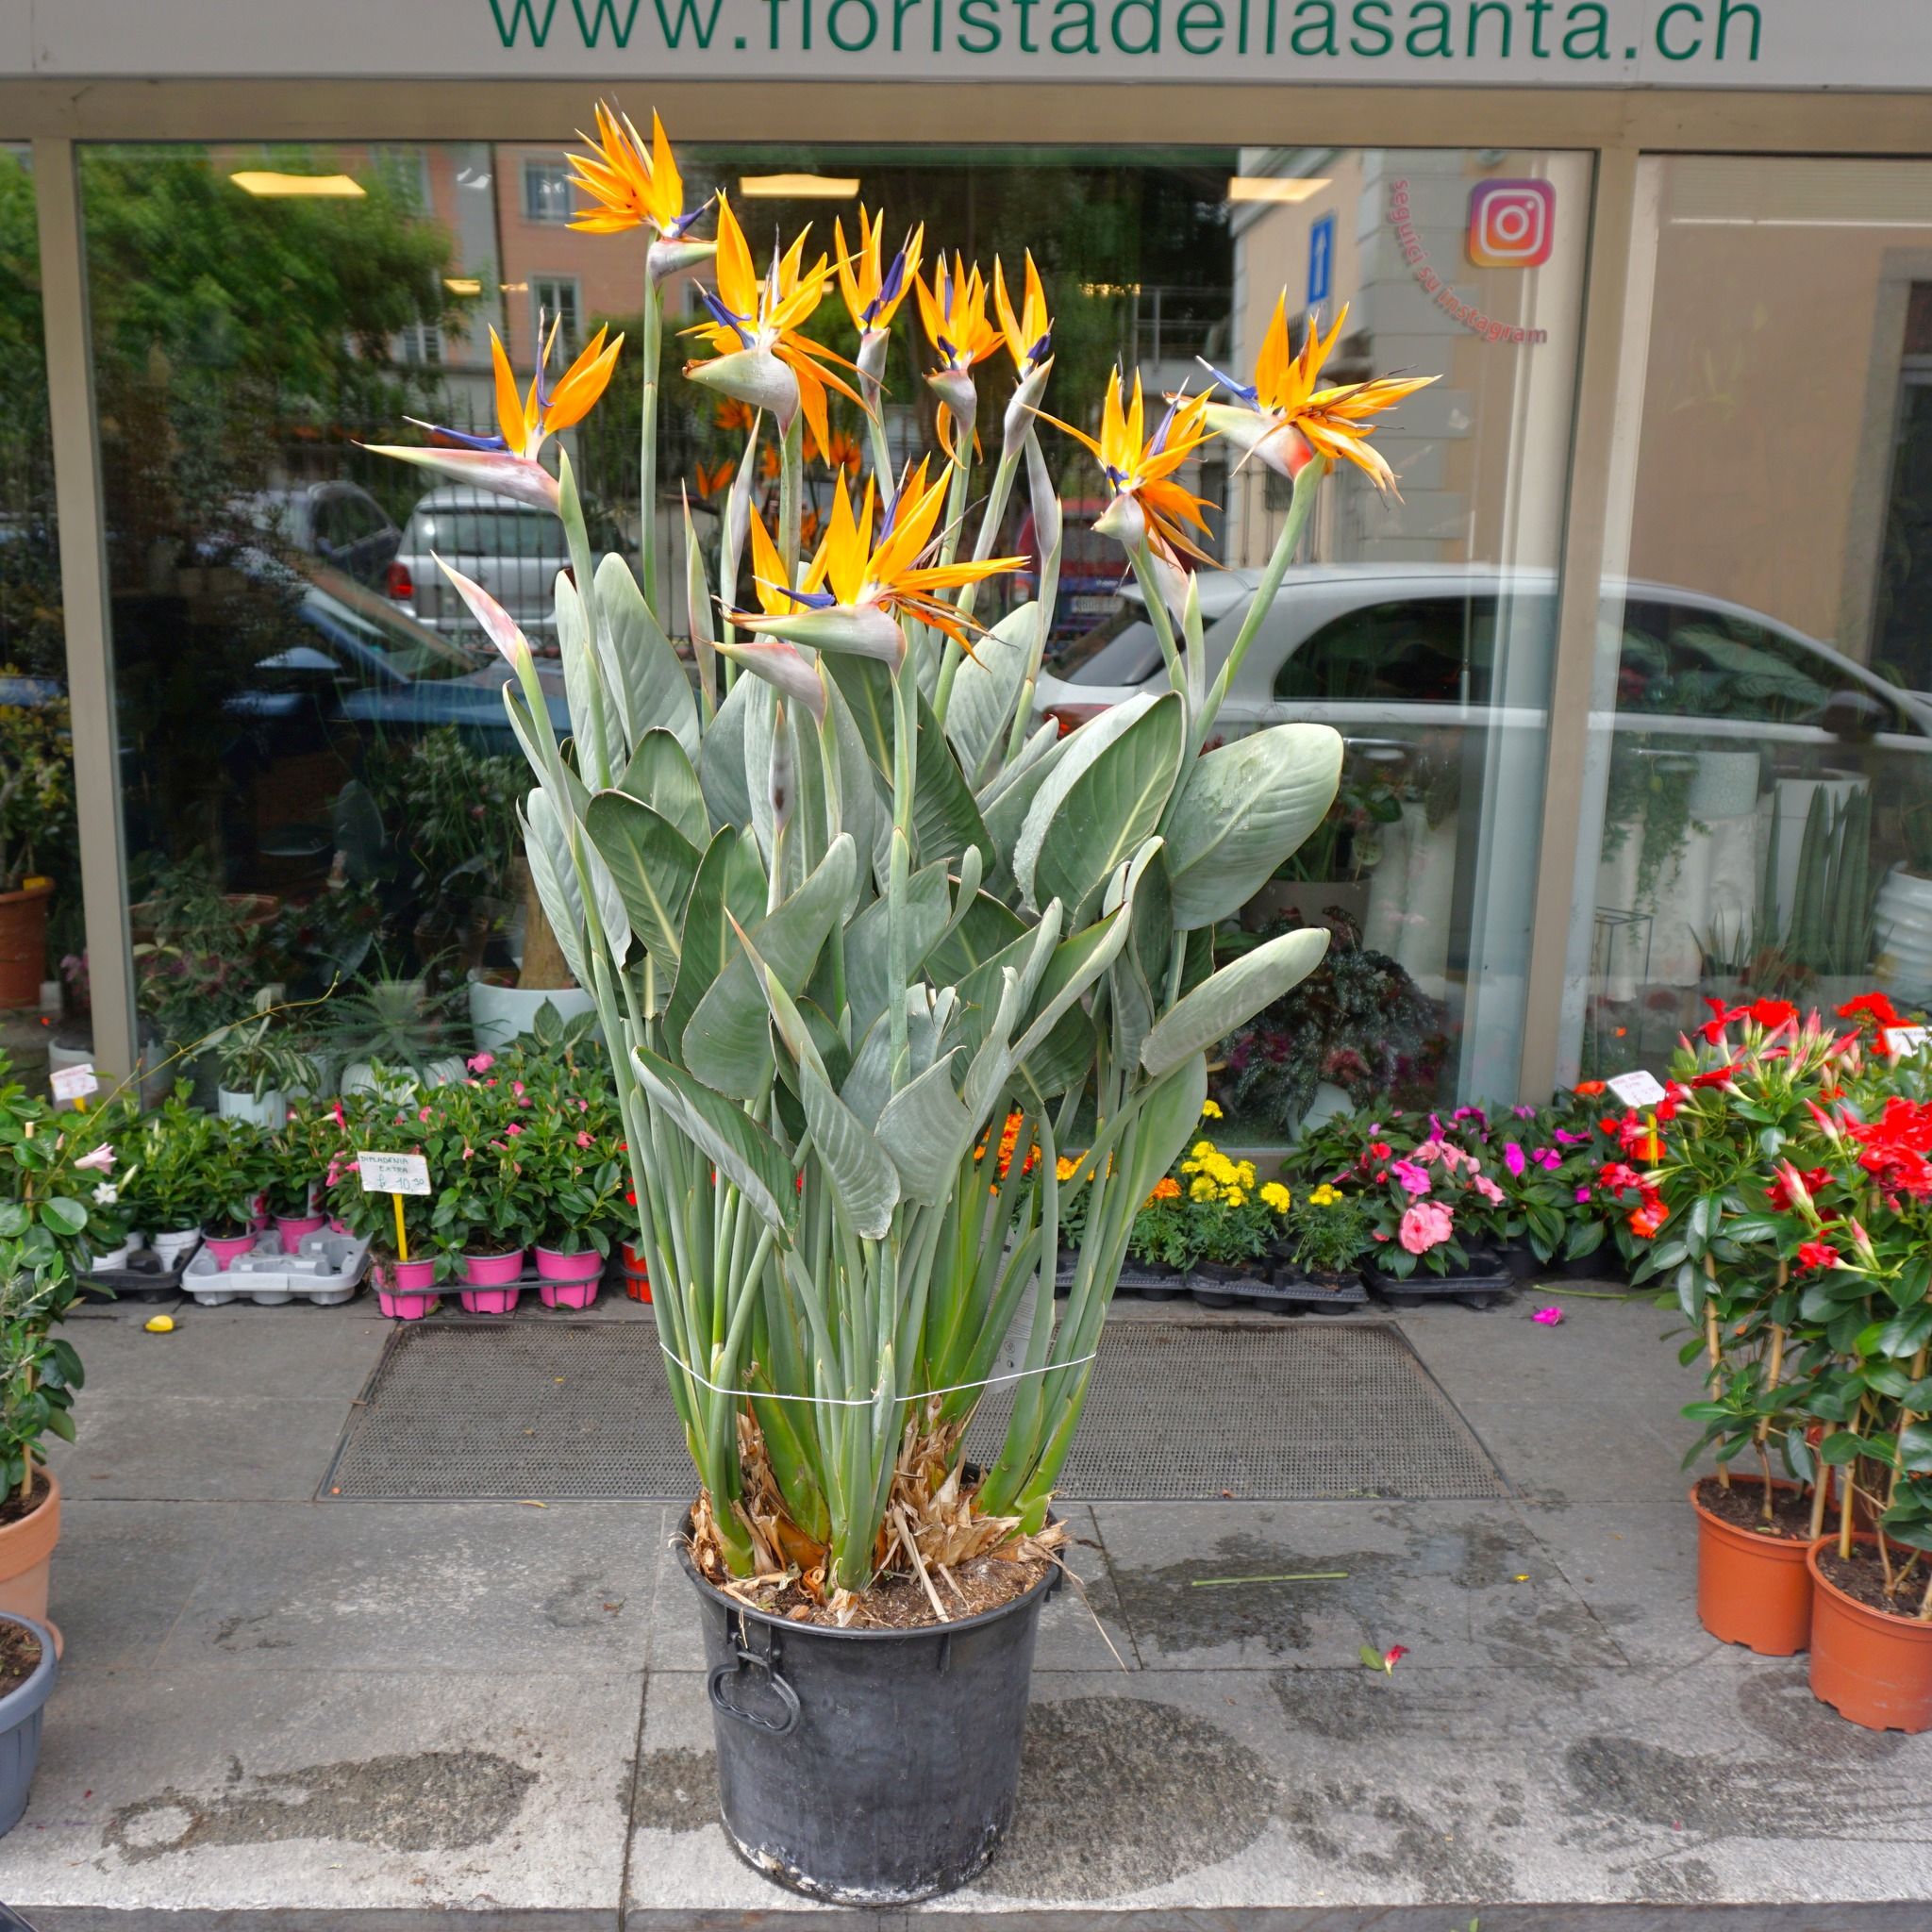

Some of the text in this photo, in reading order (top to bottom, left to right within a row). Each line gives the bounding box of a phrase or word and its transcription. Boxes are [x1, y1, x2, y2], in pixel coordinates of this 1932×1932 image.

[489, 0, 1762, 61] www.floristadellasanta.ch
[1388, 178, 1548, 343] seguici su instagram
[360, 1156, 408, 1164] DIPLADENIA
